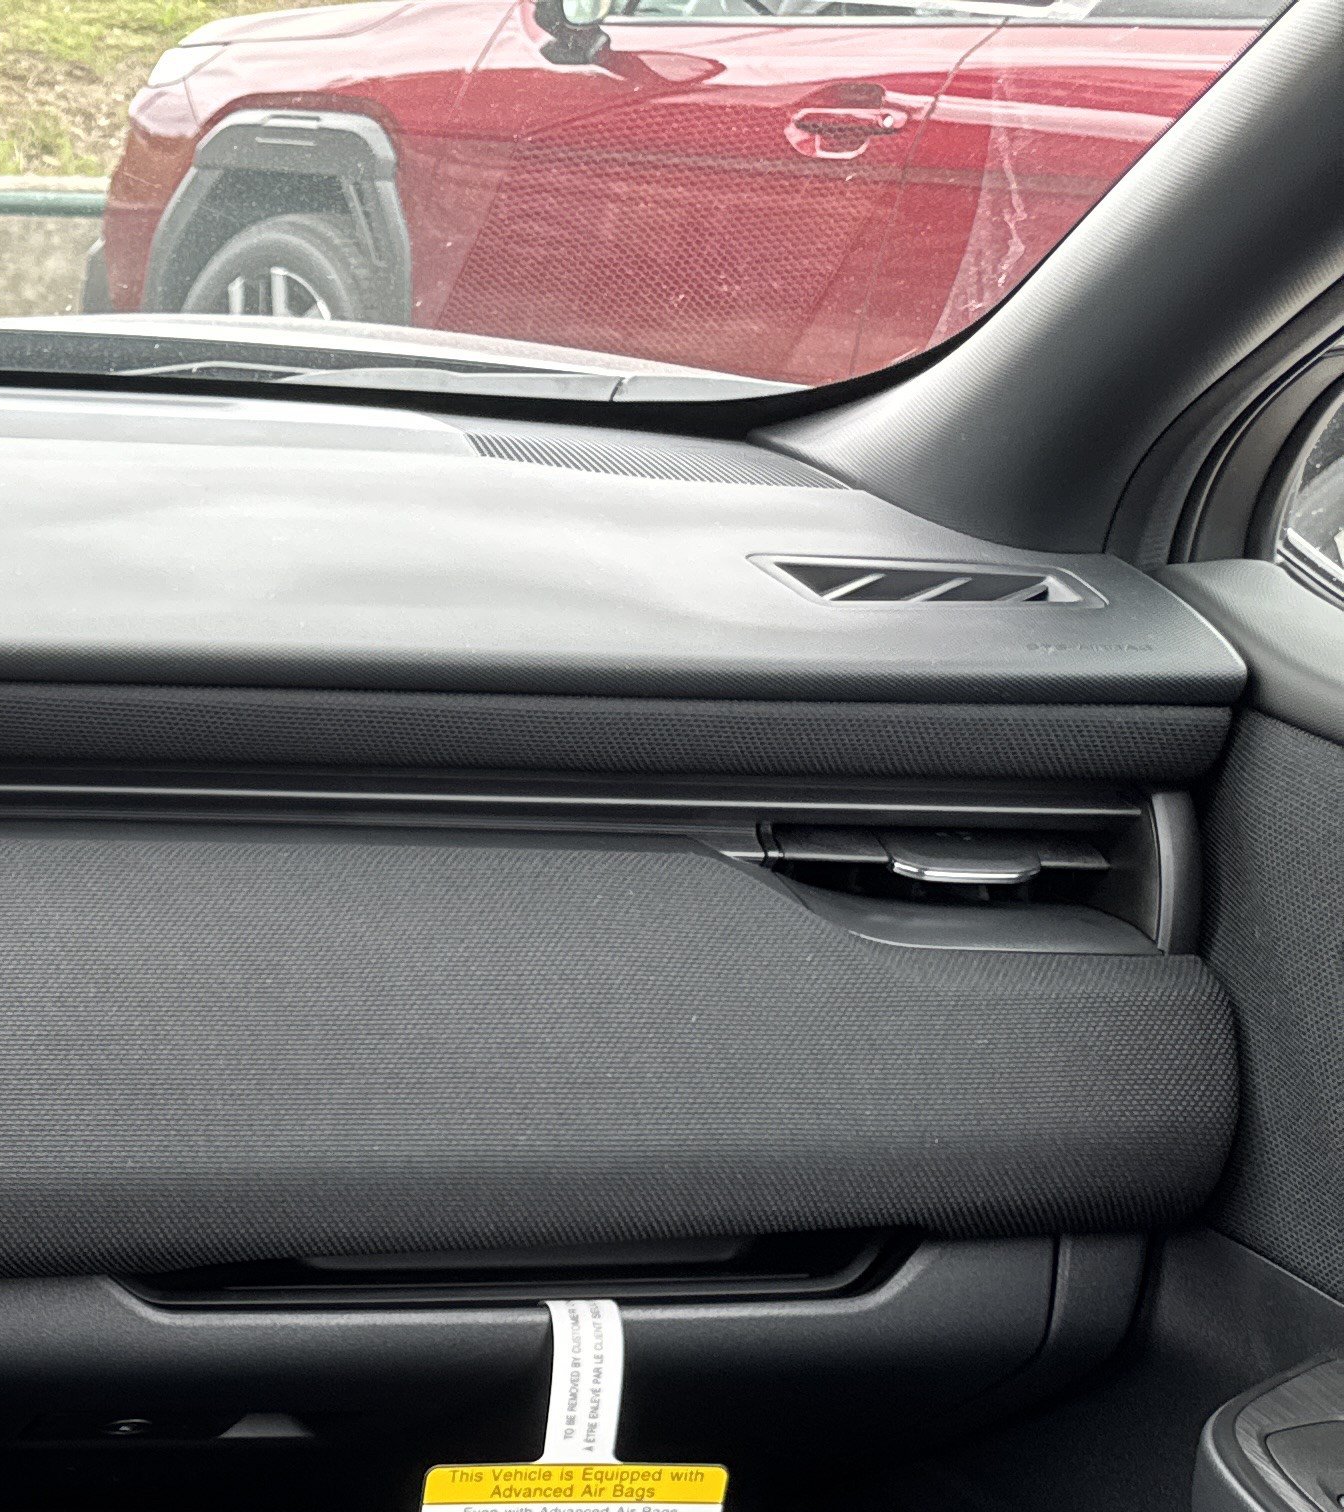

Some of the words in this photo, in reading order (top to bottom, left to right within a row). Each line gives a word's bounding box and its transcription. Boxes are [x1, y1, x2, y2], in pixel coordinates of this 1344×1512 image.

[593, 1321, 604, 1351] CLIENT
[571, 1356, 581, 1368] BY
[594, 1354, 604, 1364] LE
[593, 1367, 604, 1385] PAR
[567, 1370, 581, 1412] REMOVED
[563, 1428, 575, 1441] TO
[449, 1469, 484, 1483] This
[491, 1468, 552, 1482] Vehicle
[559, 1467, 574, 1481] is
[581, 1467, 663, 1484] Equipped
[670, 1469, 705, 1482] with
[490, 1484, 574, 1498] Advanced
[580, 1484, 605, 1498] Air
[612, 1484, 655, 1501] Bags
